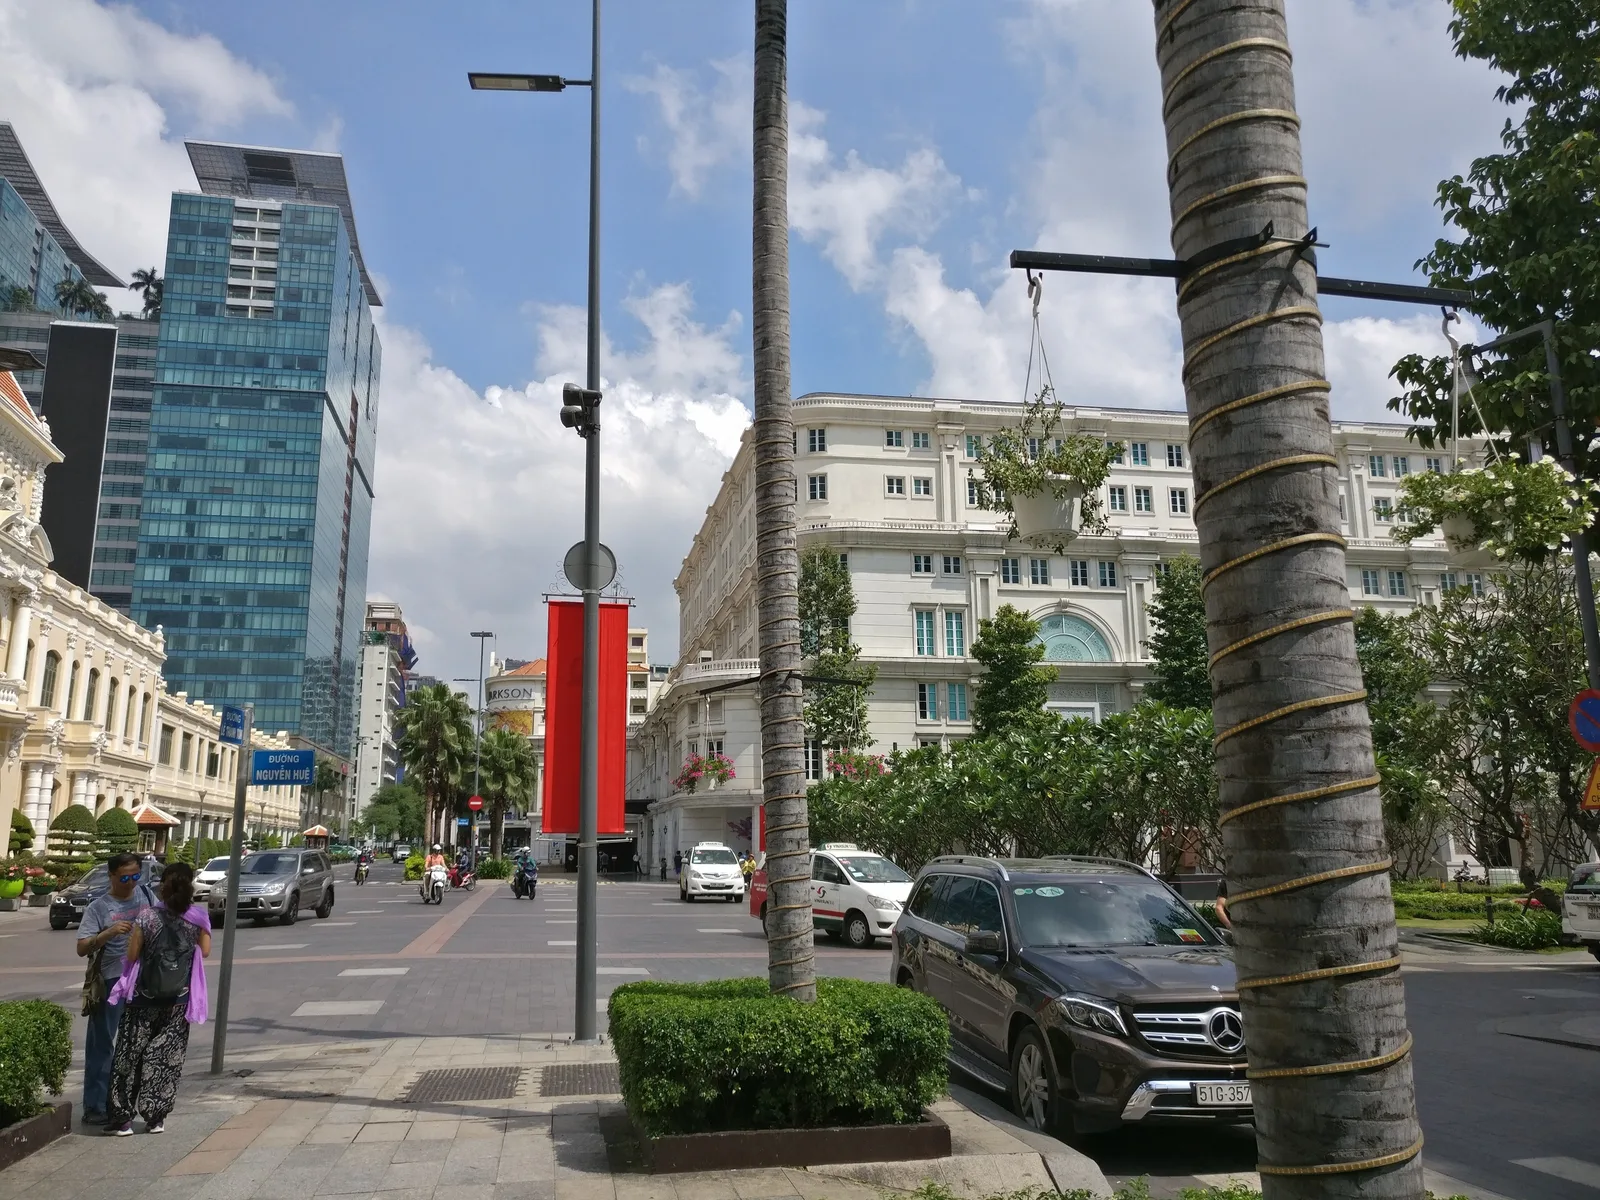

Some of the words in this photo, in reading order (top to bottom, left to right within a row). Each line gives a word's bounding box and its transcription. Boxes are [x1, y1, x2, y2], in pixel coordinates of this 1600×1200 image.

[268, 753, 300, 763] ĐƯỜNG
[256, 765, 291, 781] NGUYỄN
[293, 767, 310, 783] HUỆ
